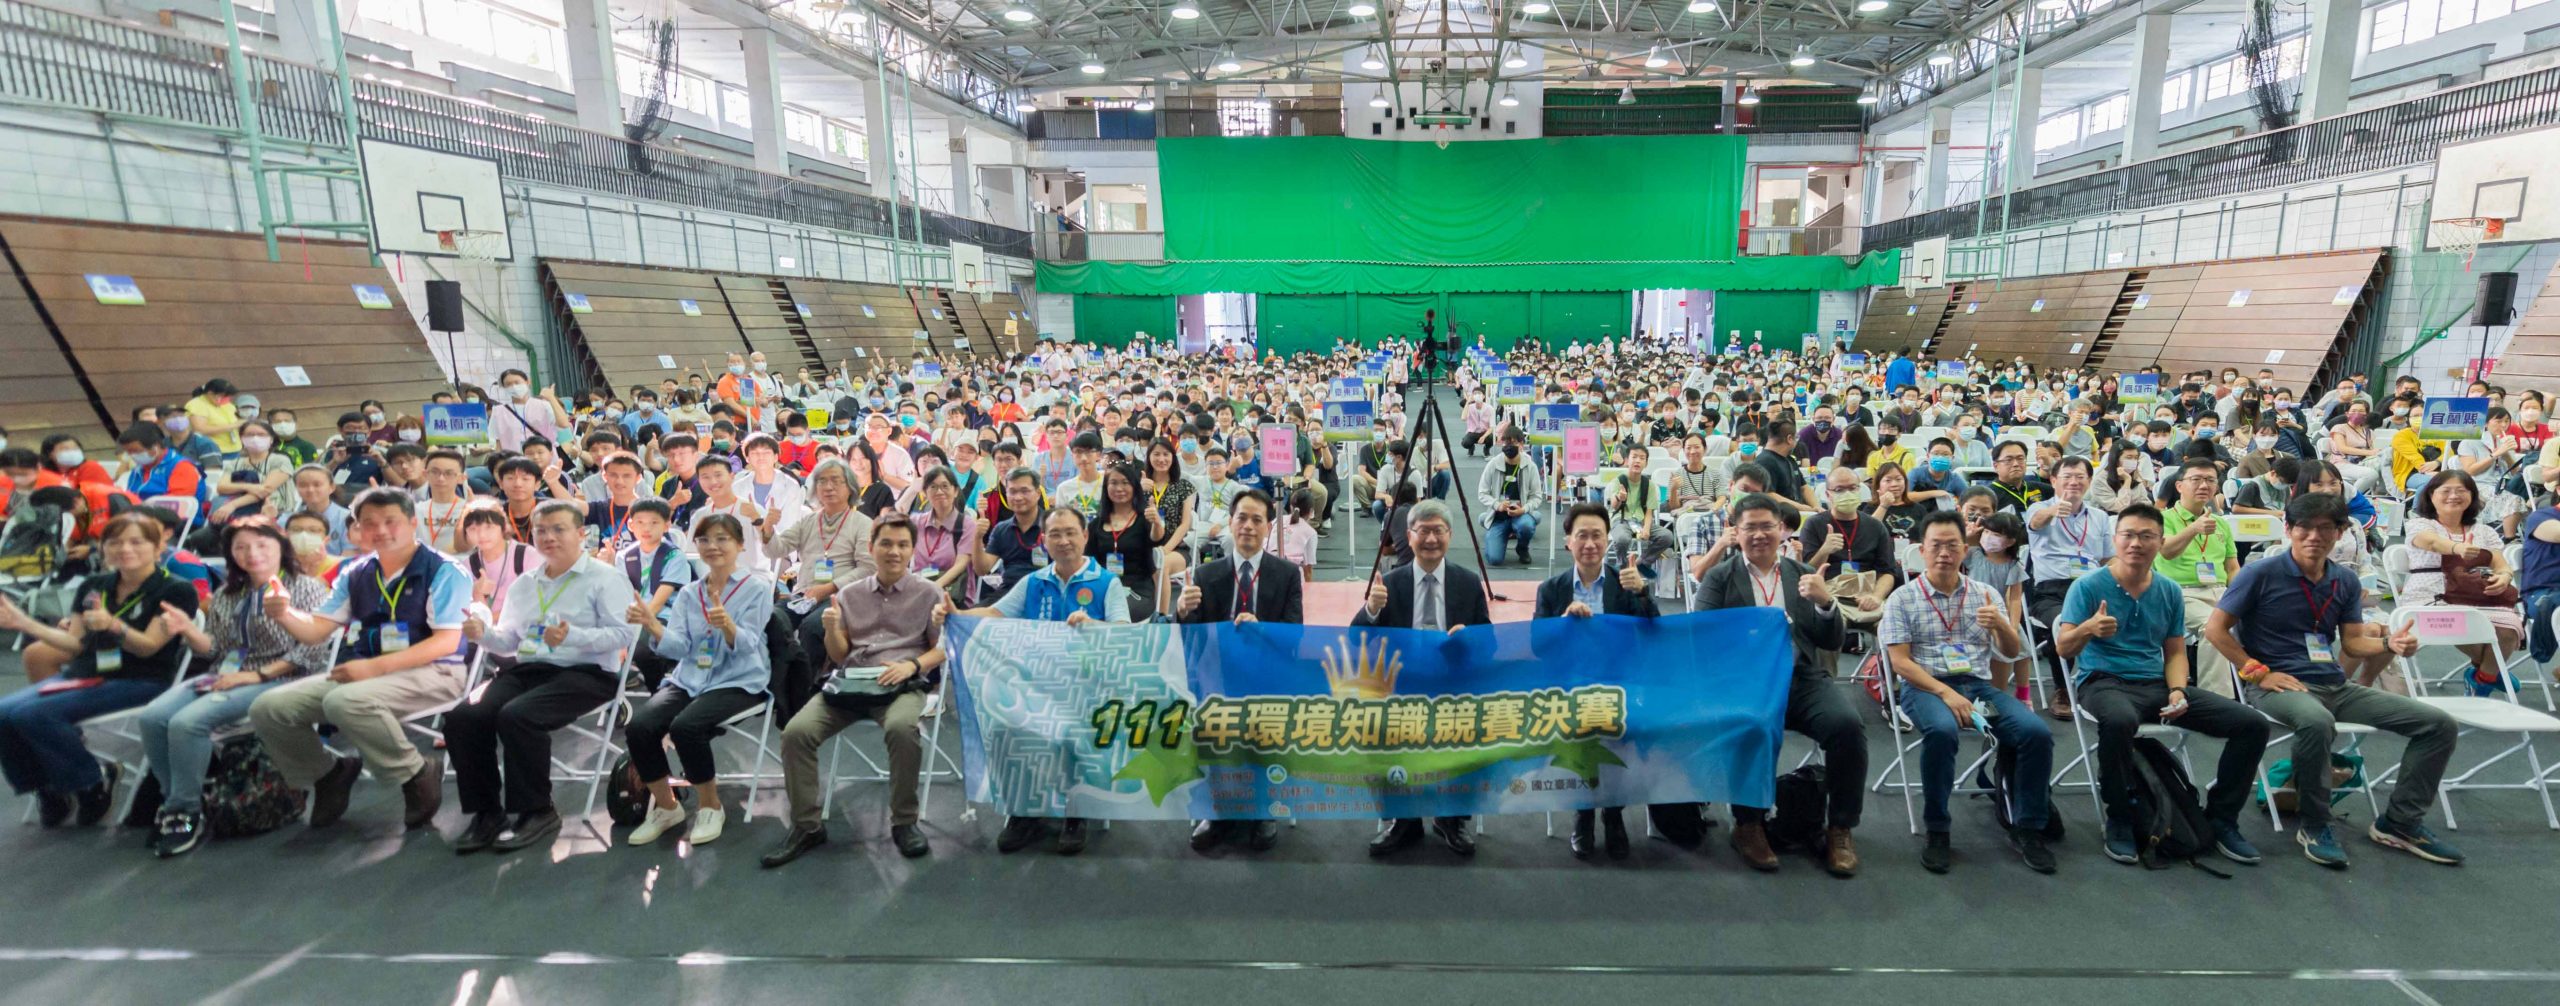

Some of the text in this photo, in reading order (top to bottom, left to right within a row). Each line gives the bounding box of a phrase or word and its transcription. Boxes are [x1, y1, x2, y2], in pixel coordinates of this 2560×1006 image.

[433, 418, 480, 431] 桃園市
[1329, 415, 1367, 428] 連江縣
[2430, 412, 2479, 425] 宜蘭縣
